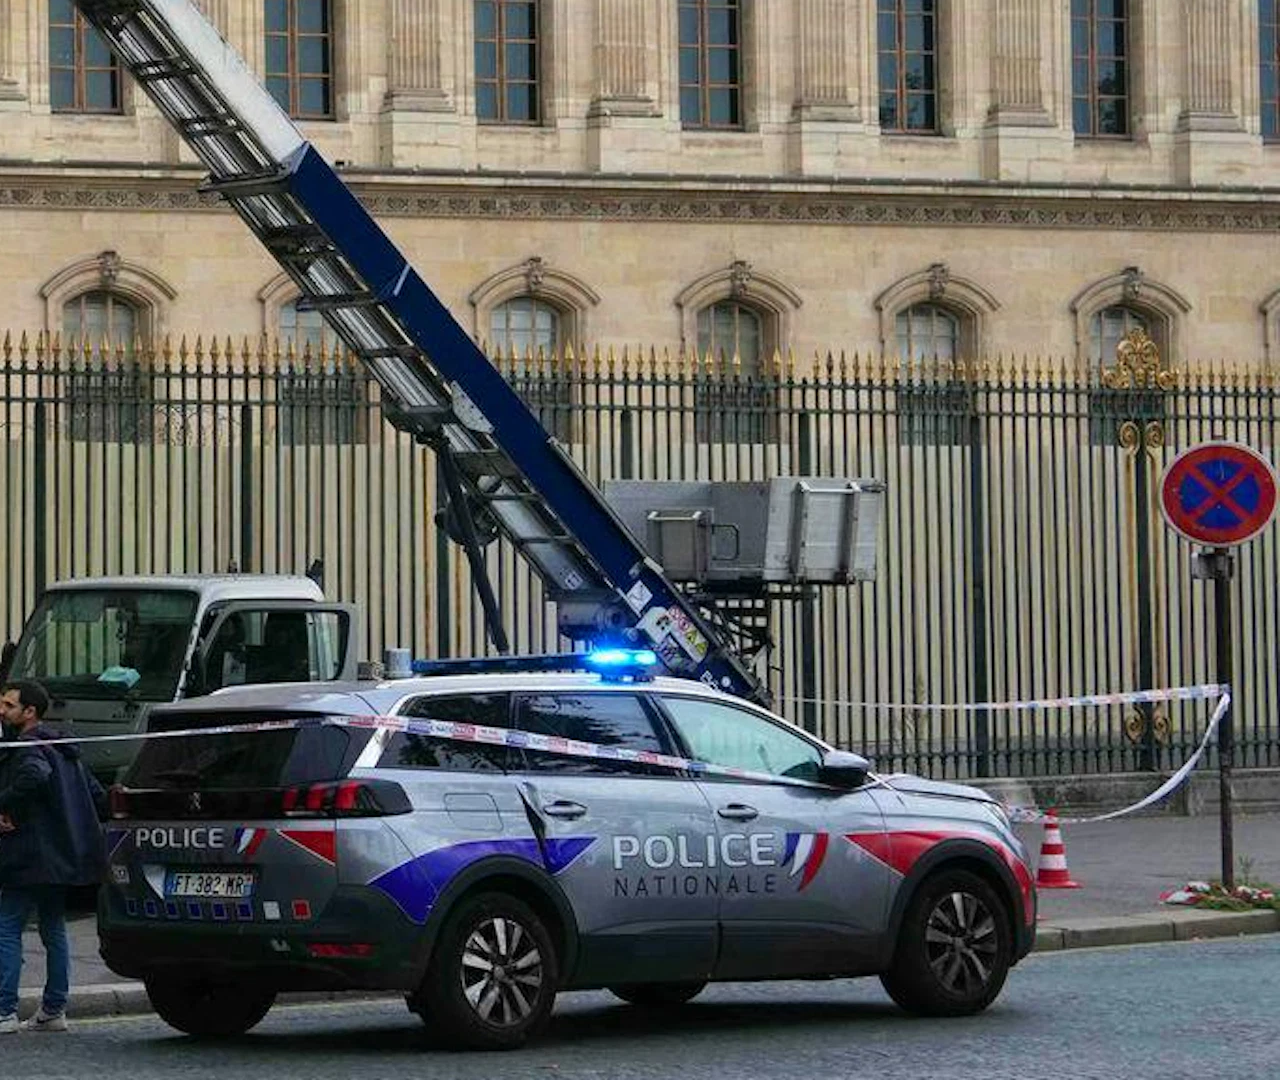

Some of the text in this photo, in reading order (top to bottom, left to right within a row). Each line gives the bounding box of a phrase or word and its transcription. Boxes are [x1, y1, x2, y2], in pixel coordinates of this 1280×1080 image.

[135, 827, 225, 849] POLICE
[613, 833, 775, 870] POLICE
[614, 875, 777, 897] NATIONALE
